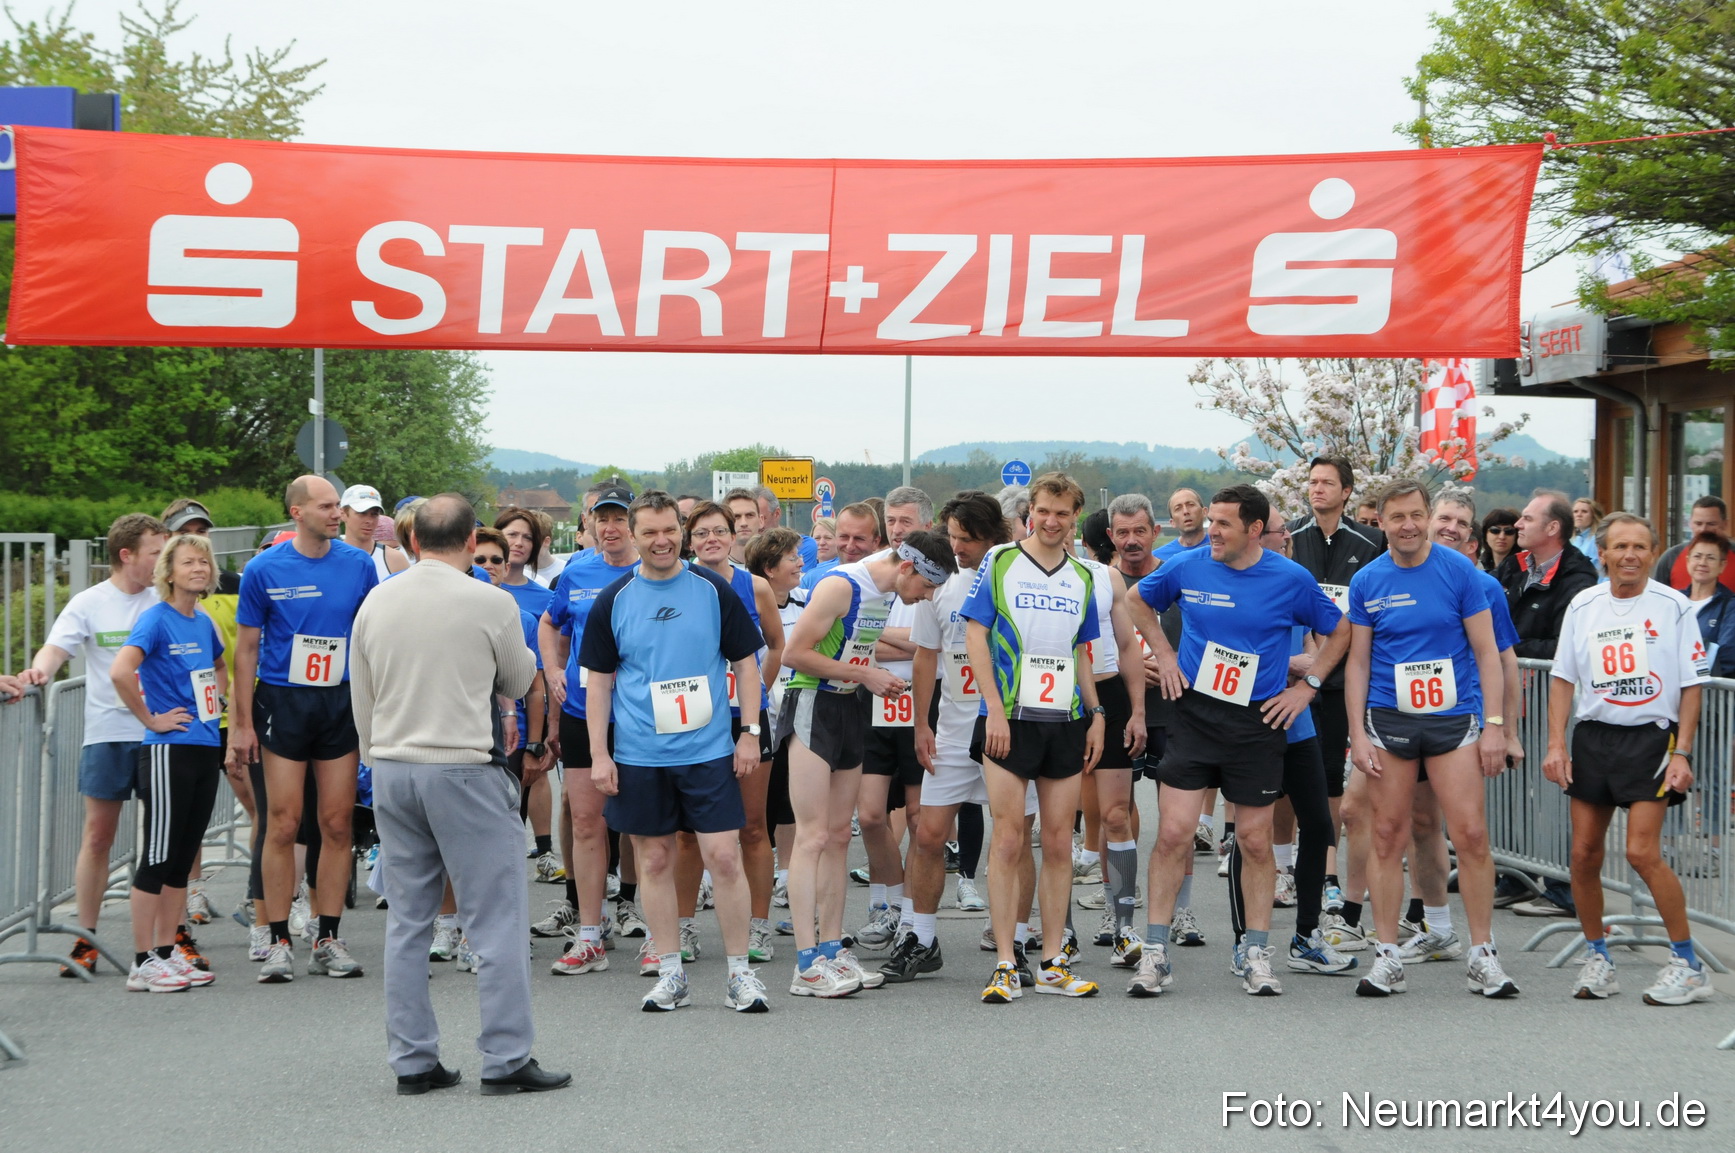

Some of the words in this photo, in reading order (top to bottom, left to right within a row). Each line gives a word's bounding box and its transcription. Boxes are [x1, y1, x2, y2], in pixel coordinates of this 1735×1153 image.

[1539, 324, 1583, 358] SEAT
[766, 474, 808, 484] Neumarkt
[817, 485, 830, 496] 60
[1017, 581, 1049, 590] TEAM
[1015, 592, 1080, 615] BOCK
[1597, 629, 1622, 638] MEYER
[1029, 657, 1056, 665] MEYER
[1214, 648, 1238, 661] MEYER
[1602, 643, 1635, 675] 86
[305, 653, 332, 682] 61
[1404, 664, 1432, 672] MEYER
[660, 681, 687, 691] MEYER
[1039, 672, 1055, 703] 2
[1212, 663, 1241, 696] 16
[1410, 677, 1444, 709] 66
[675, 694, 688, 725] 1
[884, 694, 912, 722] 59
